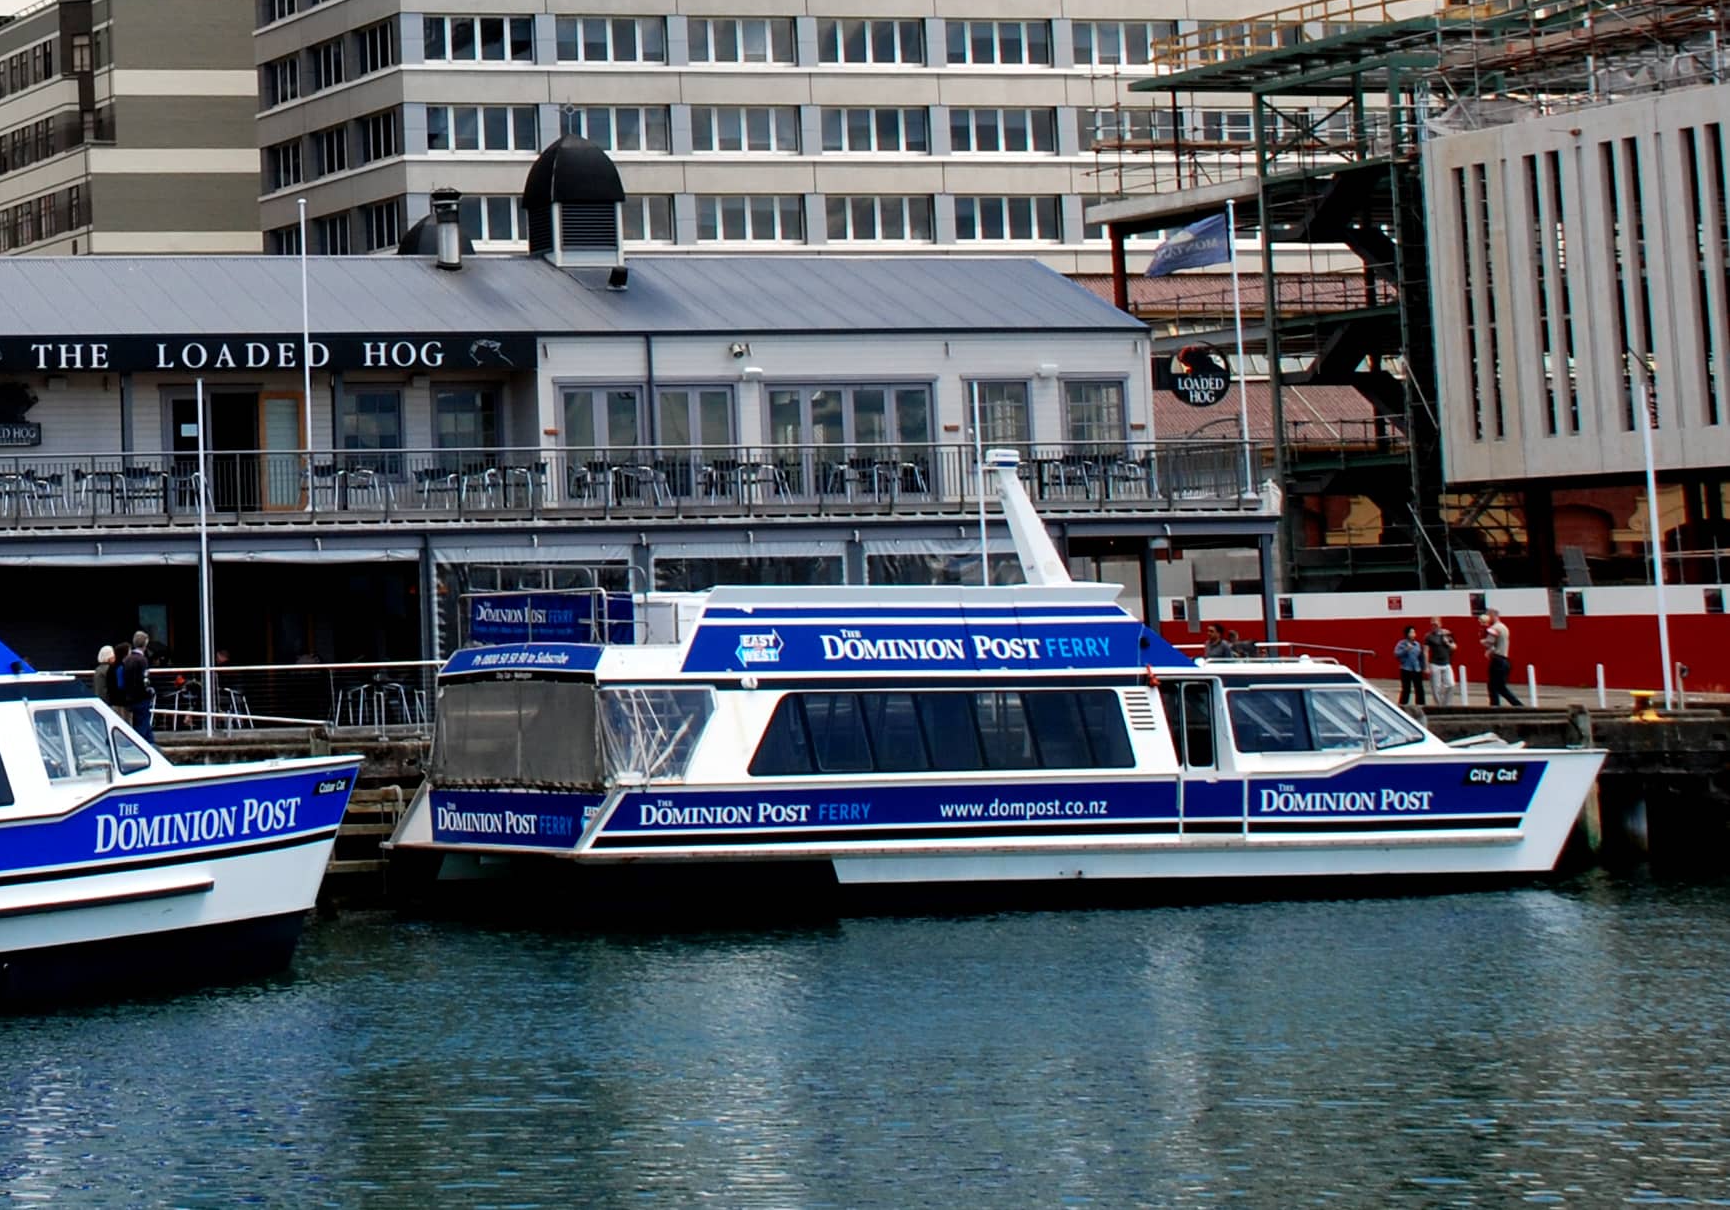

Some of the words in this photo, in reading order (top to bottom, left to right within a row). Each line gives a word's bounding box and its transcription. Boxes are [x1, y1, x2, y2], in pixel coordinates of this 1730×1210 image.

[31, 343, 110, 370] THE
[156, 341, 331, 370] LOADED
[363, 340, 447, 368] HOG
[1177, 377, 1225, 391] LOADED
[1189, 391, 1215, 404] HOG
[13, 427, 37, 440] HOG
[475, 605, 523, 624] DOMINION
[840, 628, 862, 638] THE
[819, 635, 966, 661] DOMINION
[971, 635, 1040, 660] POST
[1046, 636, 1111, 657] FERRY
[1469, 768, 1494, 783] City
[1497, 768, 1518, 782] Cat
[1278, 783, 1295, 792] THE
[657, 799, 673, 808] THE
[1260, 788, 1376, 812] DOMINION
[1381, 788, 1434, 811] POST
[118, 802, 139, 816] THE
[639, 804, 753, 826] DOMINION
[757, 802, 811, 823] POST
[819, 802, 872, 821] FERRY
[940, 797, 1108, 821] www.dompost.co.nz
[94, 805, 238, 854] DOMINION
[240, 797, 301, 835] POST
[437, 806, 503, 833] DOMINION
[505, 810, 538, 835] POST
[539, 814, 573, 836] FERRY
